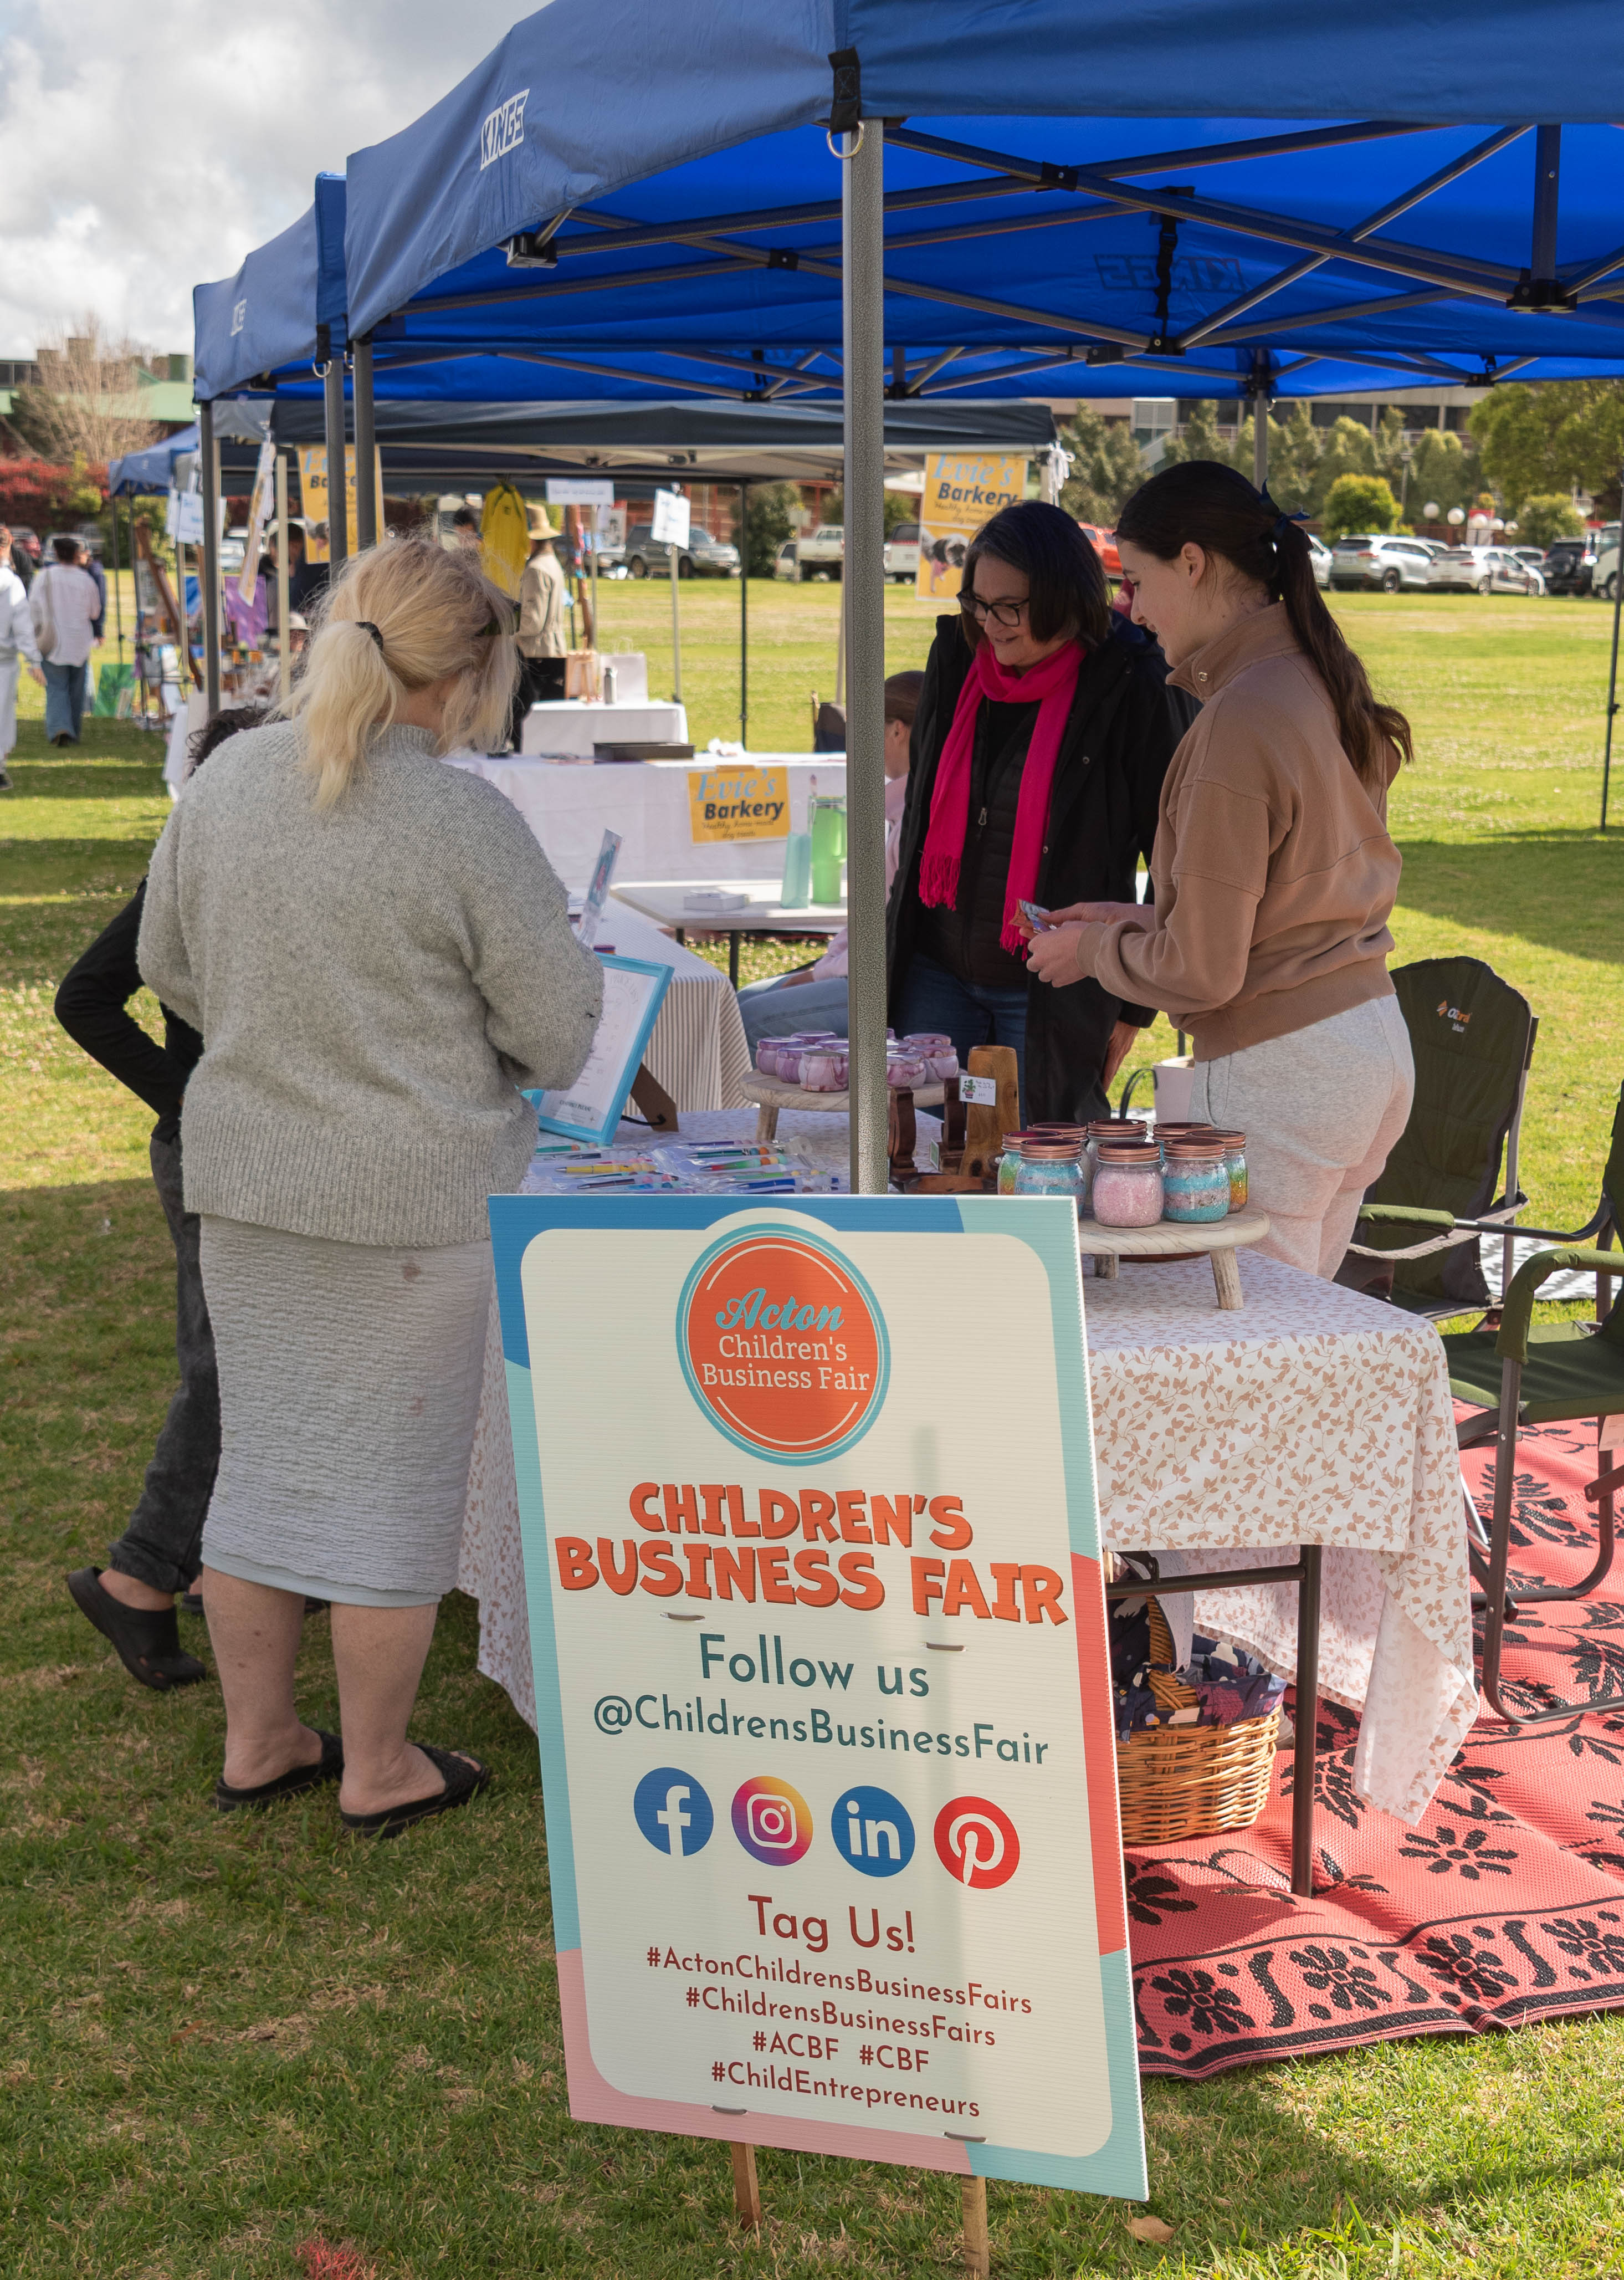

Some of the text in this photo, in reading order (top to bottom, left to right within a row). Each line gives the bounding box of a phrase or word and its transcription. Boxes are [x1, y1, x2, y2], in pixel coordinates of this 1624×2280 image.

[481, 91, 528, 168] KINGS
[933, 454, 1013, 487] Evie's
[694, 769, 776, 801] Evie's
[704, 800, 785, 821] Barkery
[716, 1289, 845, 1331] Acton
[719, 1334, 848, 1361] Children's
[702, 1363, 870, 1391] Business Fair
[629, 1482, 974, 1551] CHILDREN'S
[555, 1536, 1069, 1626] BUSINESS FAIR
[700, 1633, 929, 1697] Follow us
[594, 1693, 1049, 1765] @ChildrensBusinessFair
[747, 1894, 915, 1953] Tag Us!
[647, 1946, 1032, 2014] #ActonChildrensBusinessFairs
[685, 1986, 996, 2046] #ChildrensBusinessFairs
[752, 2030, 930, 2073] #ACBF #CBF
[711, 2061, 980, 2117] #ChildEntrepreneurs
